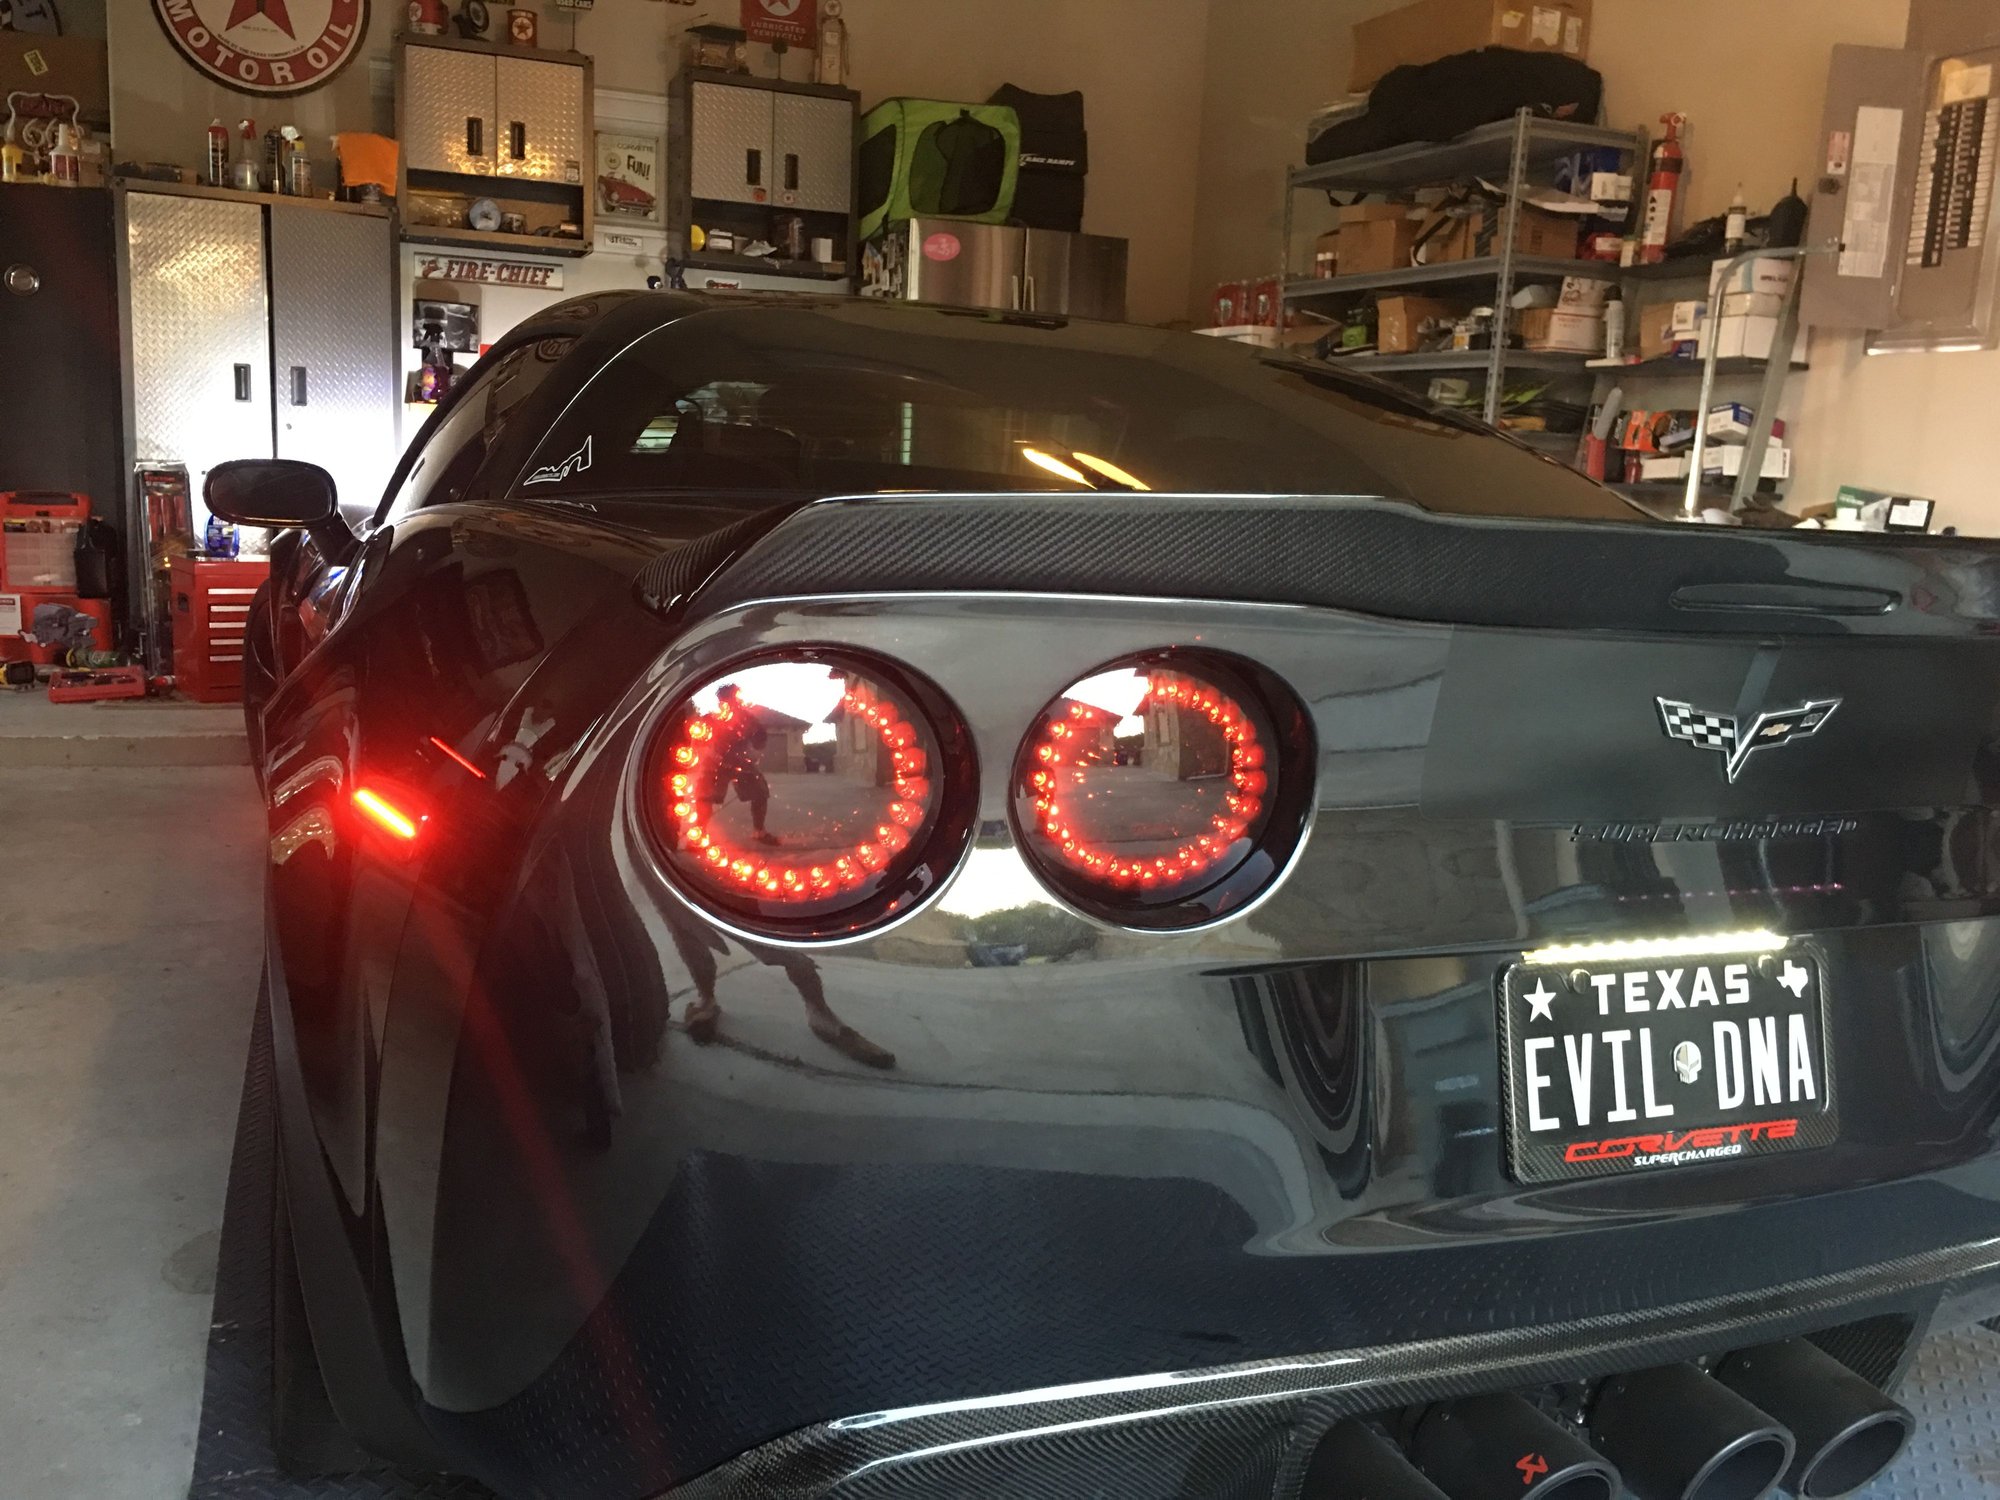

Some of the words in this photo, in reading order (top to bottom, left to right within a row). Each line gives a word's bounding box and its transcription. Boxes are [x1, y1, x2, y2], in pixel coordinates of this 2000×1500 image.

[750, 21, 807, 34] LUBRICATES
[165, 0, 296, 85] MOTOR
[306, 23, 353, 69] OIL
[627, 154, 651, 180] FUN!
[443, 259, 554, 286] FIRE-CHIEF
[1569, 819, 1857, 842] SUPERCHARGED
[1590, 964, 1750, 1016] TEXAS
[1524, 1027, 1675, 1132] EVIL
[1713, 1013, 1816, 1110] DNA
[1564, 1119, 1799, 1163] CORVETTE
[1633, 1143, 1742, 1167] SUPERCHARGED
